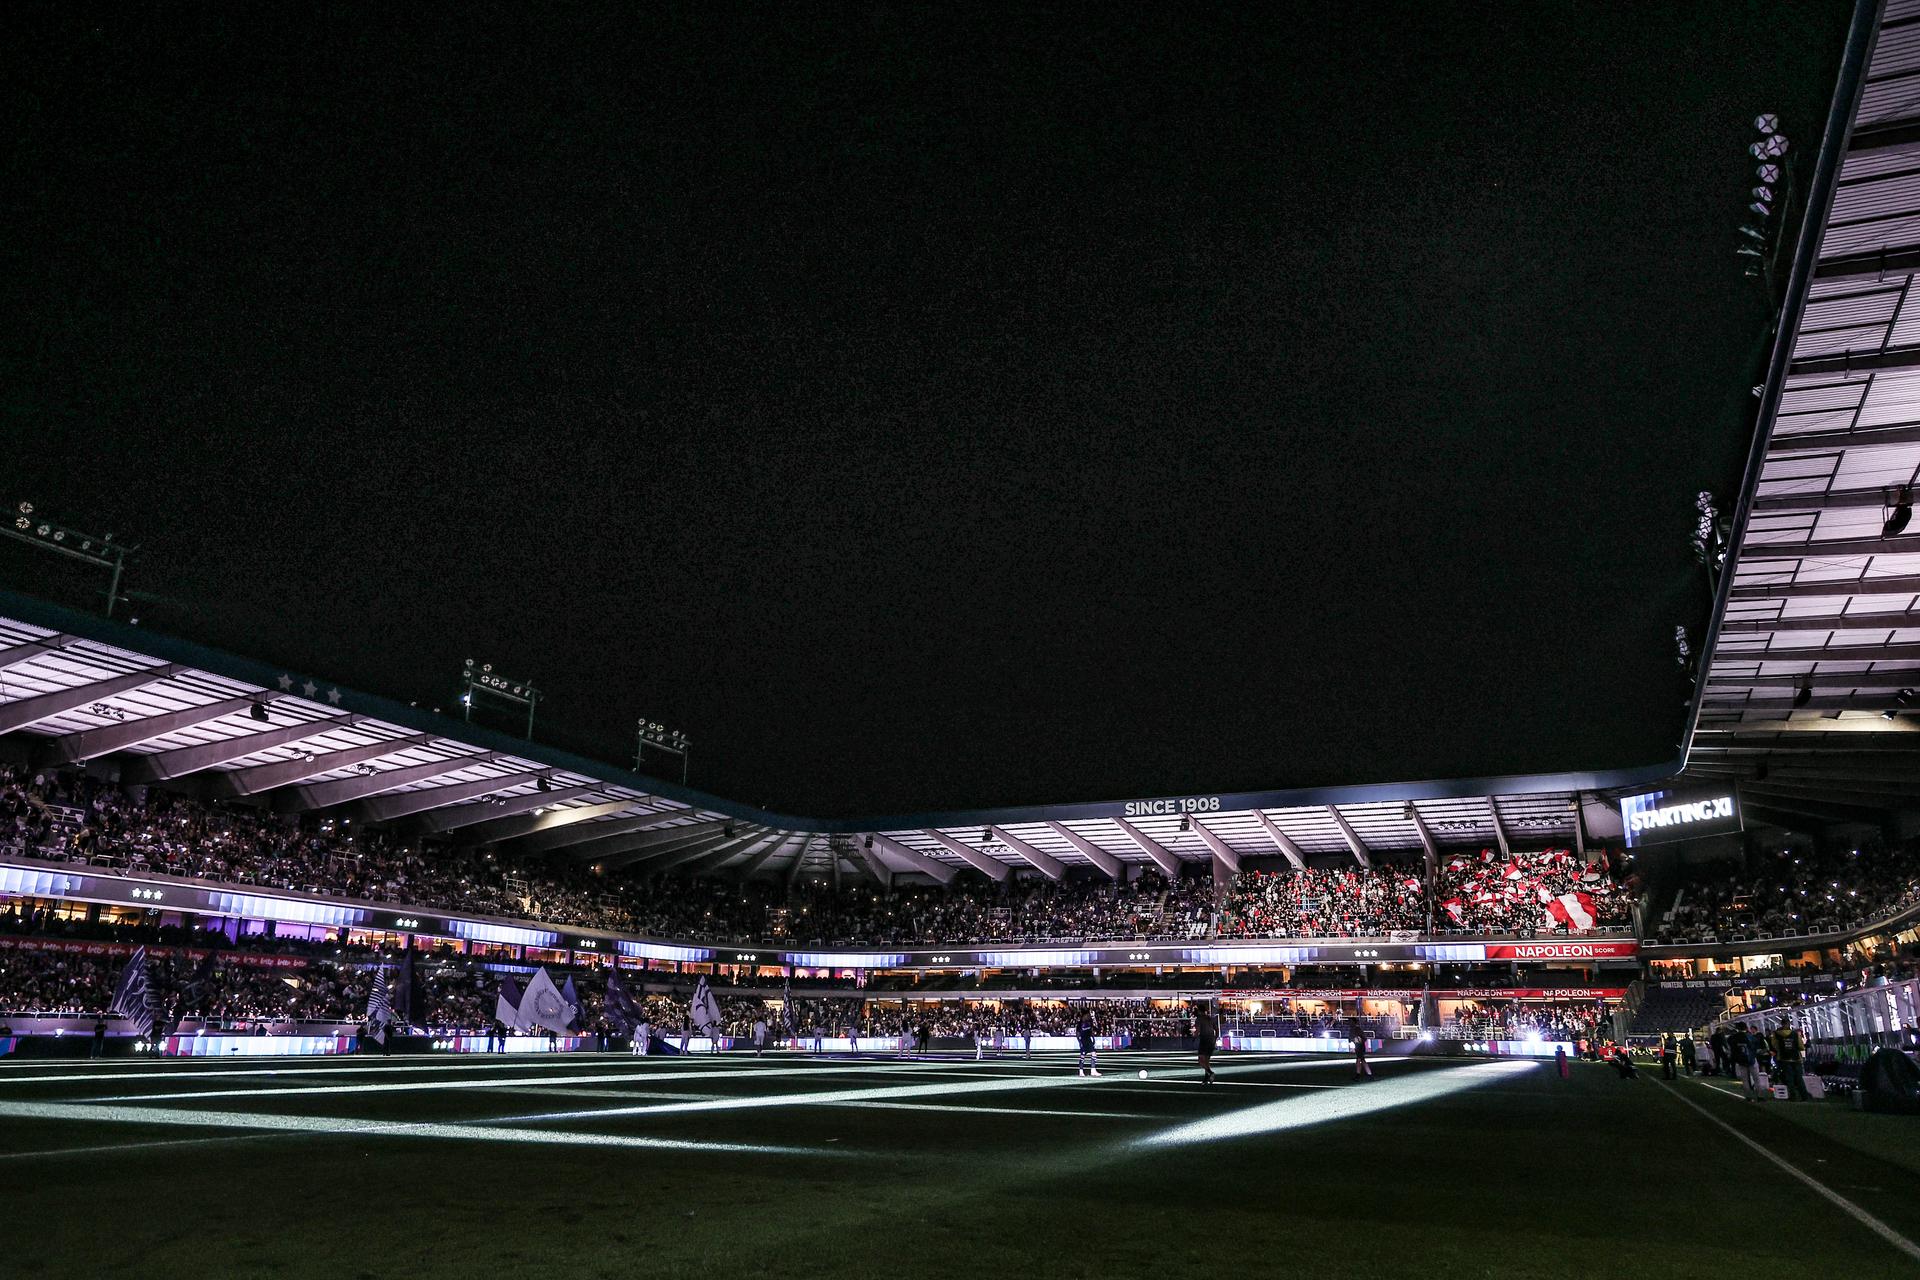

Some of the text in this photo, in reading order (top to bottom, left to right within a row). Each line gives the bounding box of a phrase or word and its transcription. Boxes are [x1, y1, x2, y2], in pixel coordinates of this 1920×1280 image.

[1125, 797, 1220, 816] SINCE 1908
[1630, 797, 1733, 831] STARTING XI
[1515, 945, 1594, 957] NAPOLEON
[1367, 989, 1410, 997] NAPOLEON
[1457, 989, 1503, 997] NAPOLEON
[1543, 989, 1591, 997] NAPOLEON
